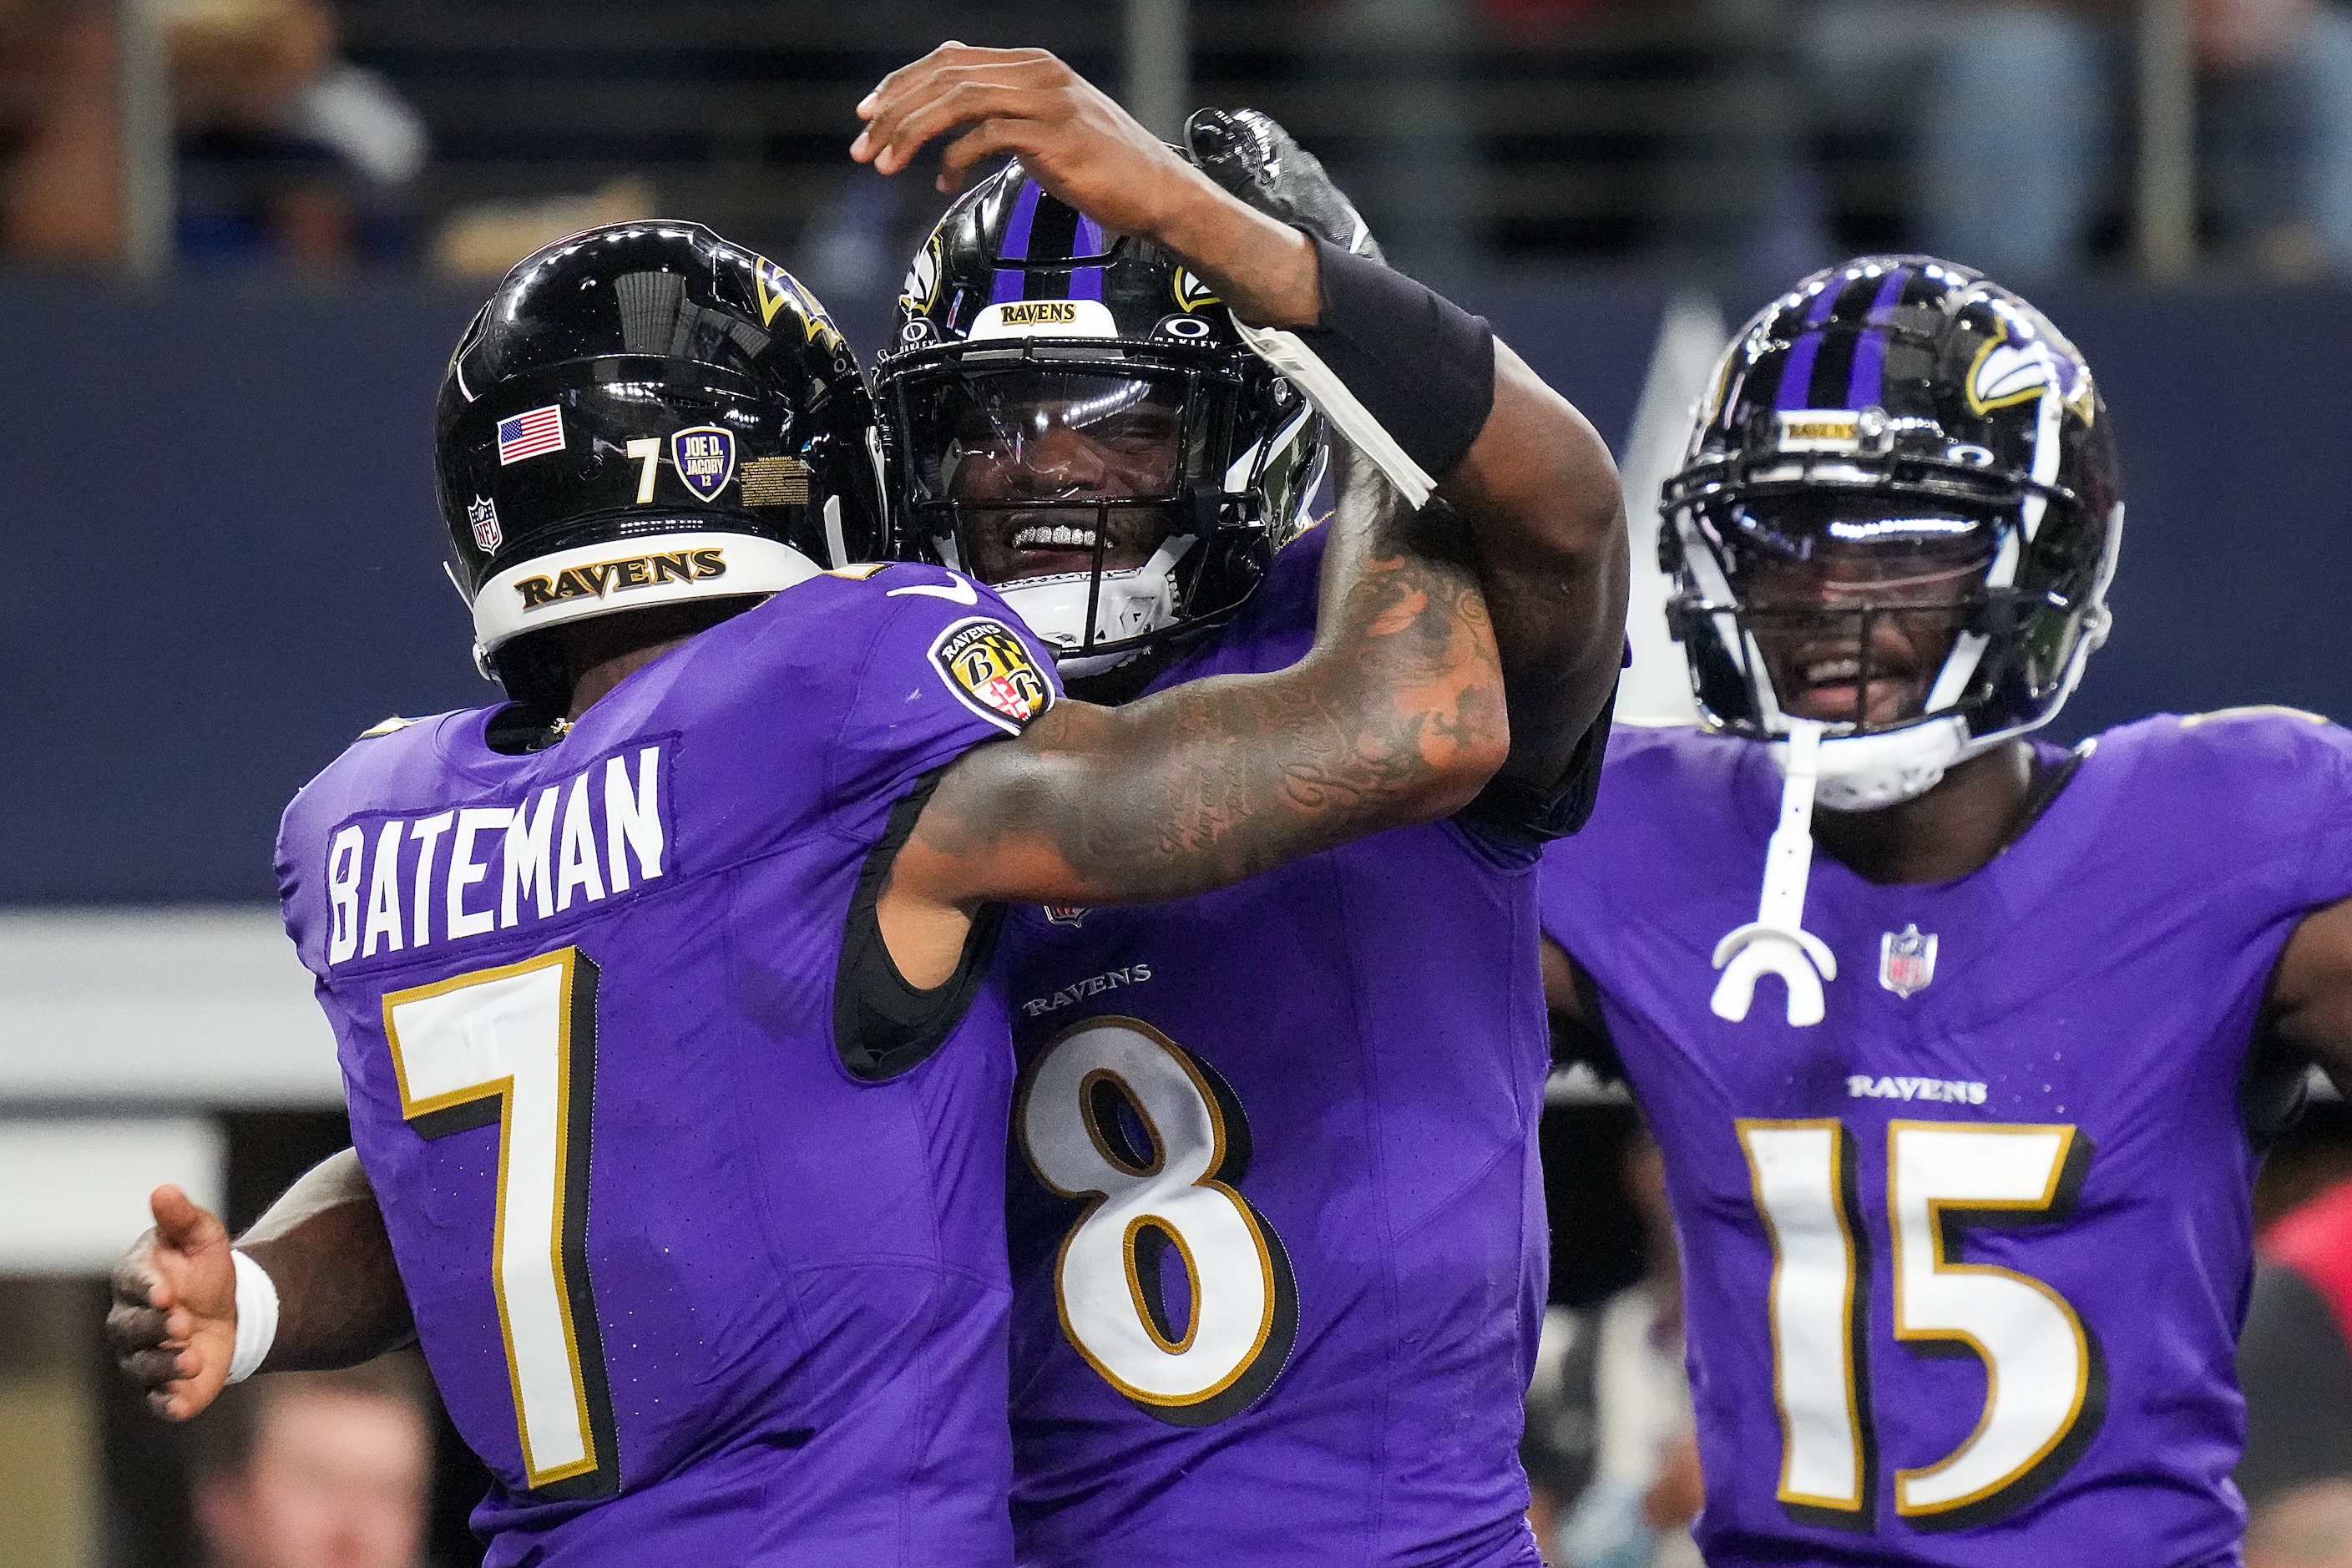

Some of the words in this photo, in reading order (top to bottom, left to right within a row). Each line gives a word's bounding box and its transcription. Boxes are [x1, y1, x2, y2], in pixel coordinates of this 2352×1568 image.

[1000, 303, 1076, 326] RAVENS
[685, 436, 708, 457] JOE
[709, 436, 724, 456] D.
[686, 458, 724, 476] JACOBY
[626, 437, 661, 503] 7
[701, 474, 712, 487] 12
[476, 520, 498, 546] NFL
[513, 547, 727, 613] RAVENS
[942, 625, 1002, 662] RAVENS
[329, 746, 664, 965] BATEMAN
[1022, 964, 1151, 1017] RAVENS
[1845, 1075, 1988, 1105] RAVENS
[382, 943, 621, 1495] 7
[1016, 1015, 1301, 1427] 8
[1734, 1116, 2110, 1533] 15
